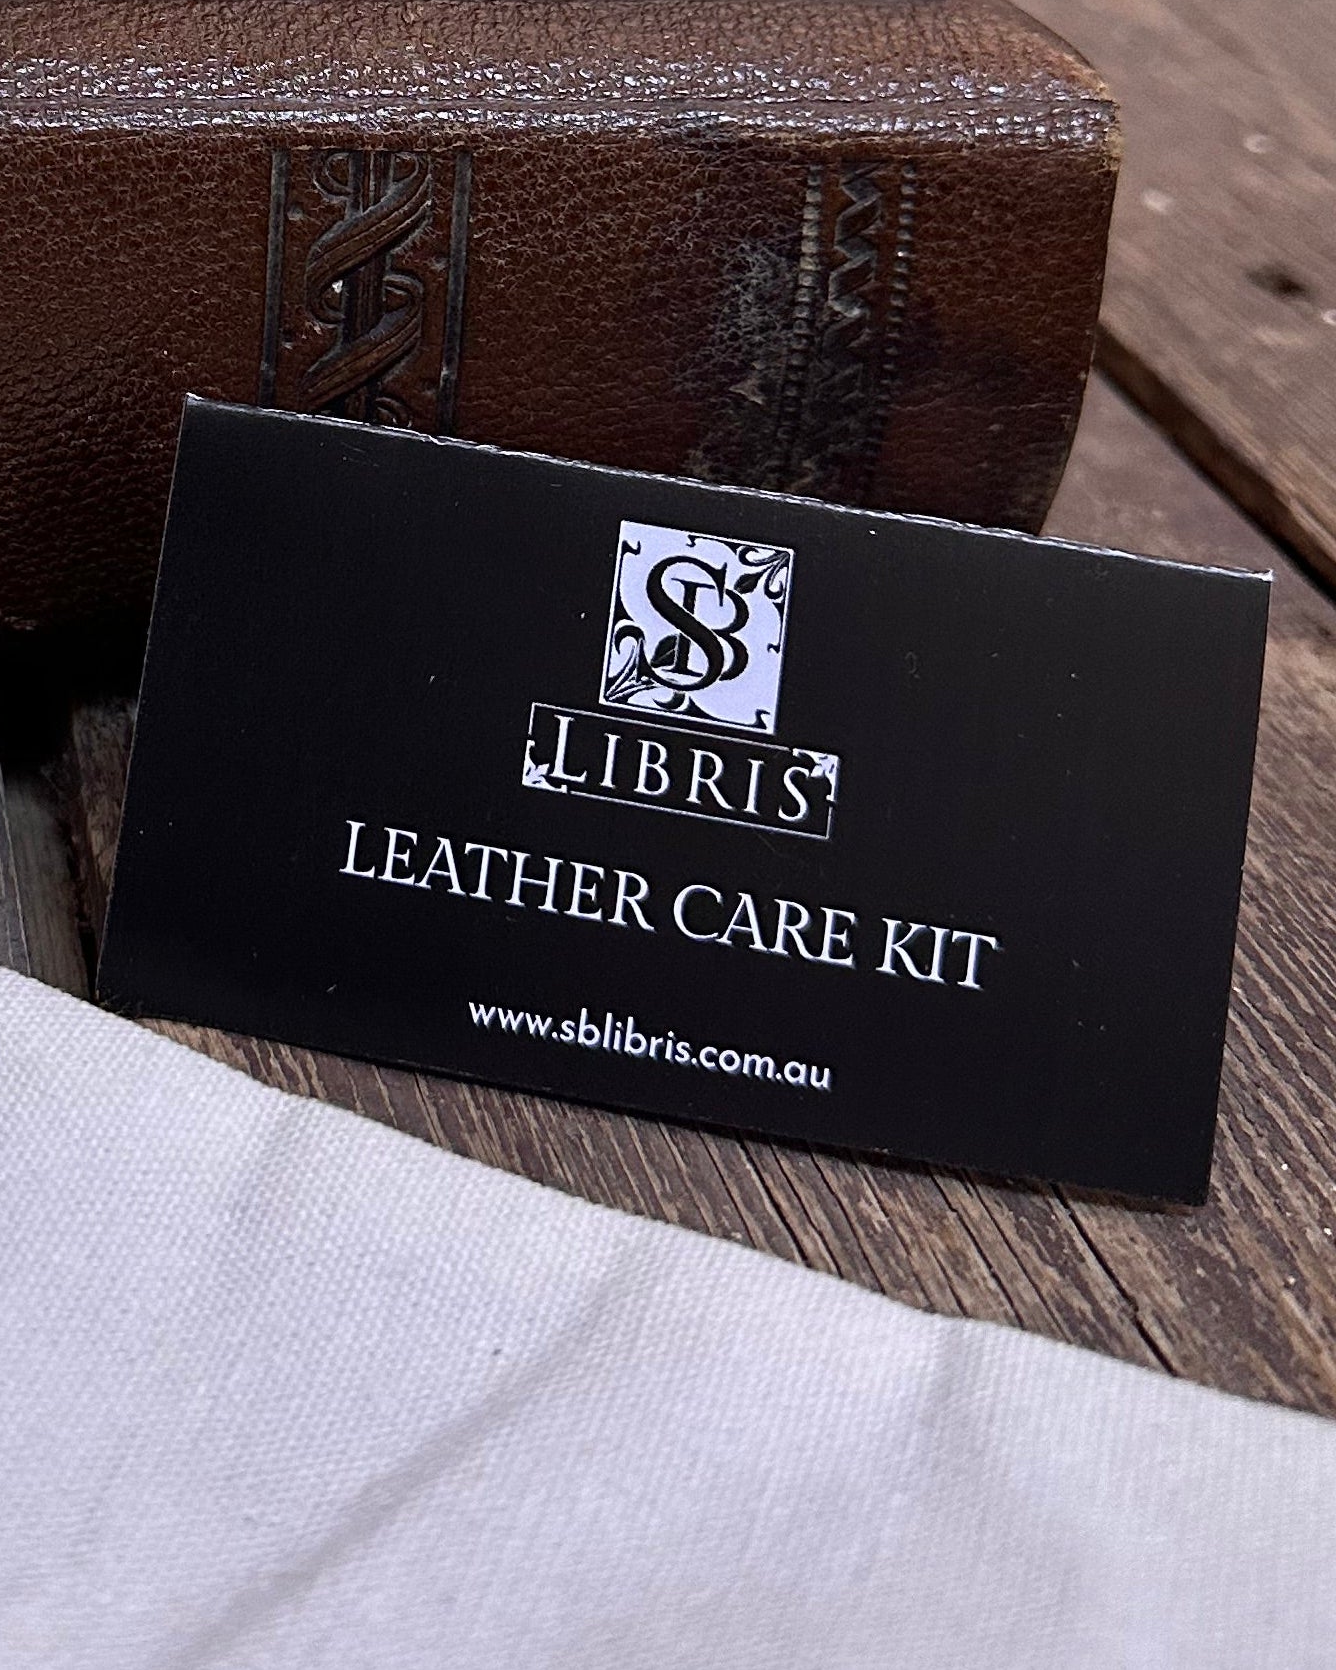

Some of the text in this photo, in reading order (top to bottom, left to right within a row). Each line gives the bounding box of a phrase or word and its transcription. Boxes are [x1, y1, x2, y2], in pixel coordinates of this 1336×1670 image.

[548, 714, 813, 823] LIBRIS
[338, 820, 1000, 991] LEATHER CARE KIT
[467, 999, 833, 1093] www.sblibris.com.au
